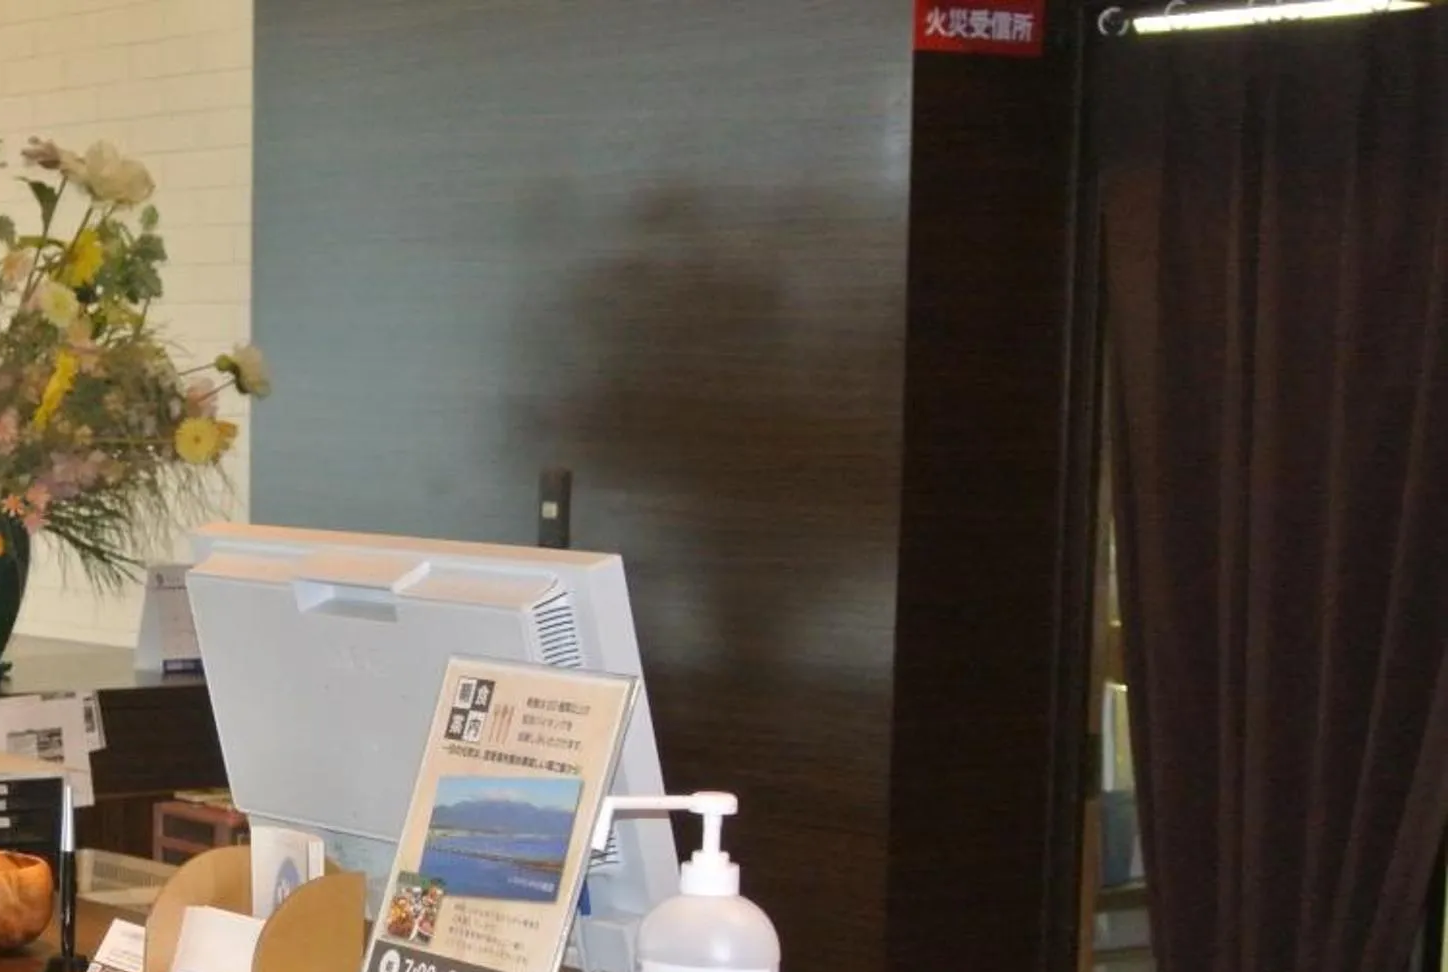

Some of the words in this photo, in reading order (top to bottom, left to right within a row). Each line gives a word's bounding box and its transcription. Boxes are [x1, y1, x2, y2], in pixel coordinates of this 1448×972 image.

[924, 6, 1035, 42] 火災受信所
